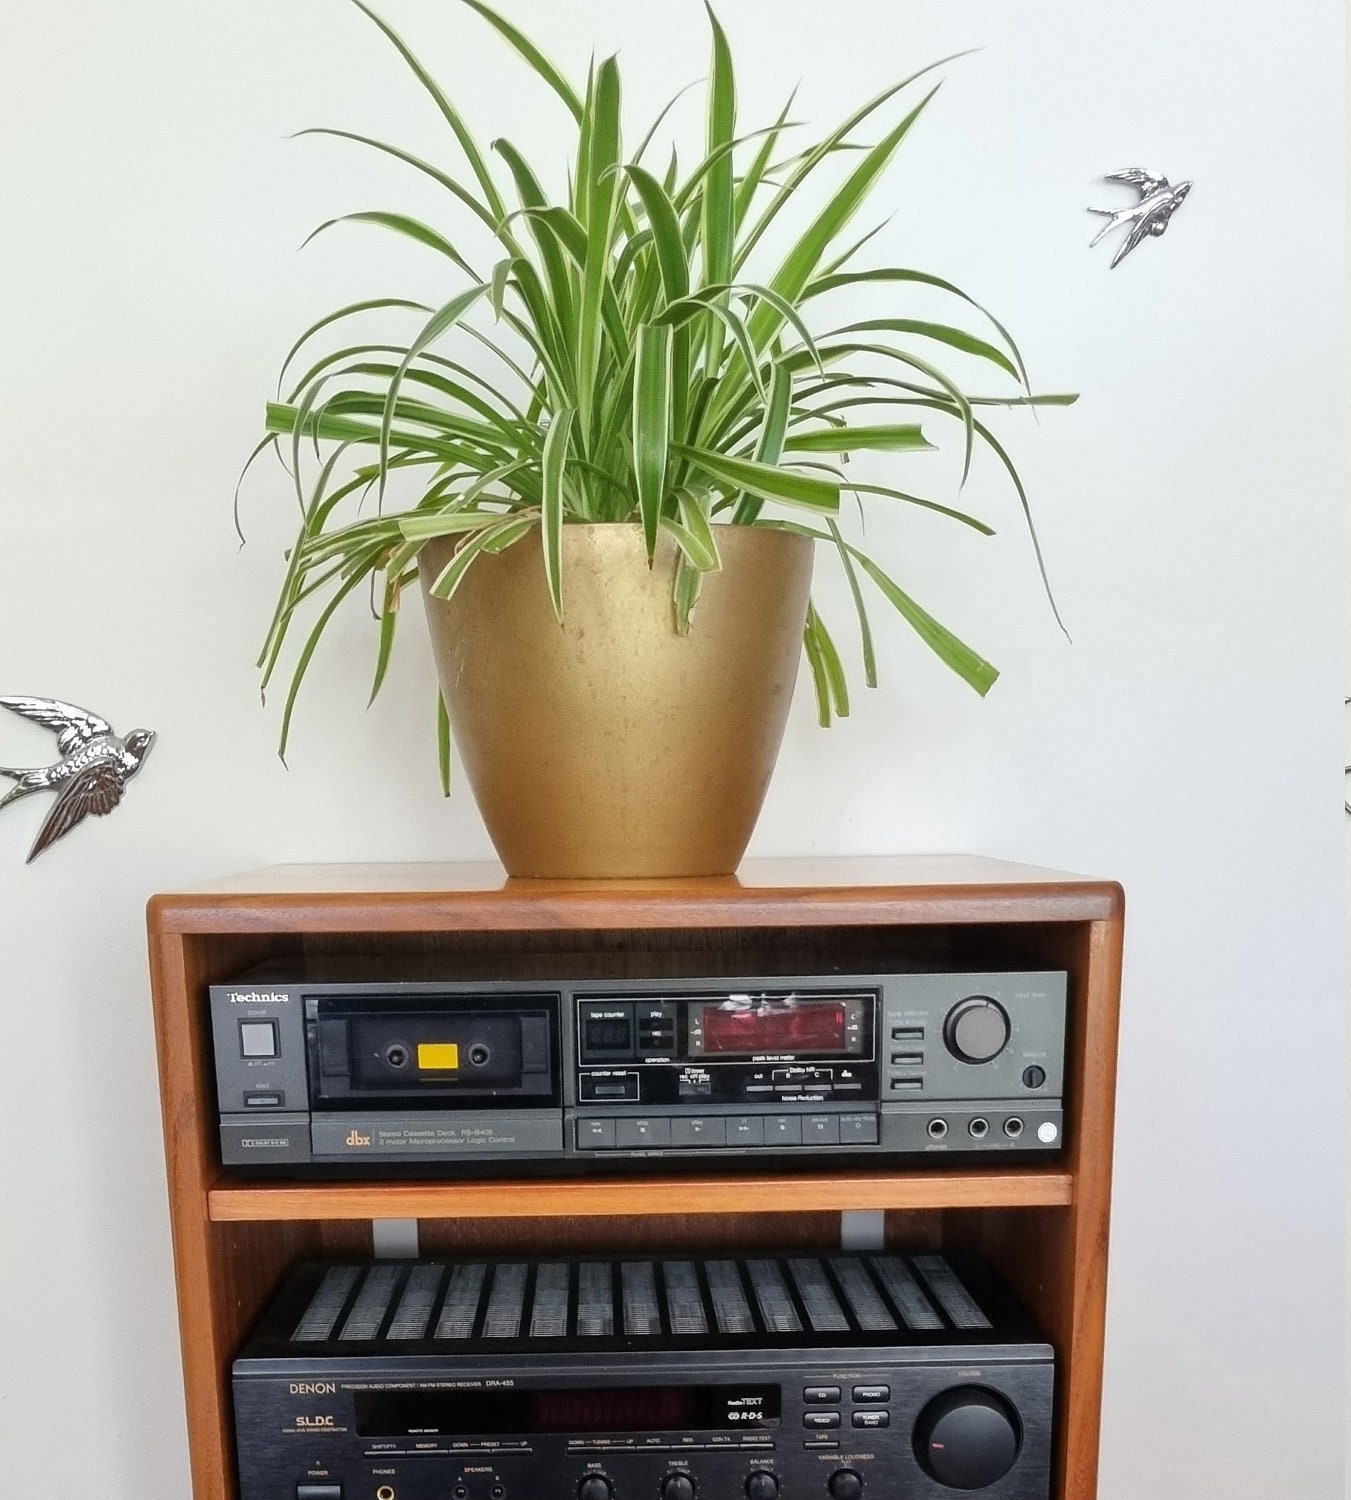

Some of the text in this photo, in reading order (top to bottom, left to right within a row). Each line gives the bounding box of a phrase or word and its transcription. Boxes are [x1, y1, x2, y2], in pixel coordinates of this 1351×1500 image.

[227, 992, 289, 1003] Technics
[798, 1094, 824, 1102] Reduction
[346, 1130, 371, 1146] dbx
[409, 1138, 465, 1146] Microprocessor
[467, 1137, 486, 1145] Logic
[488, 1136, 516, 1144] Control
[290, 1383, 336, 1394] DENON
[728, 1397, 763, 1406] RadioTEXT
